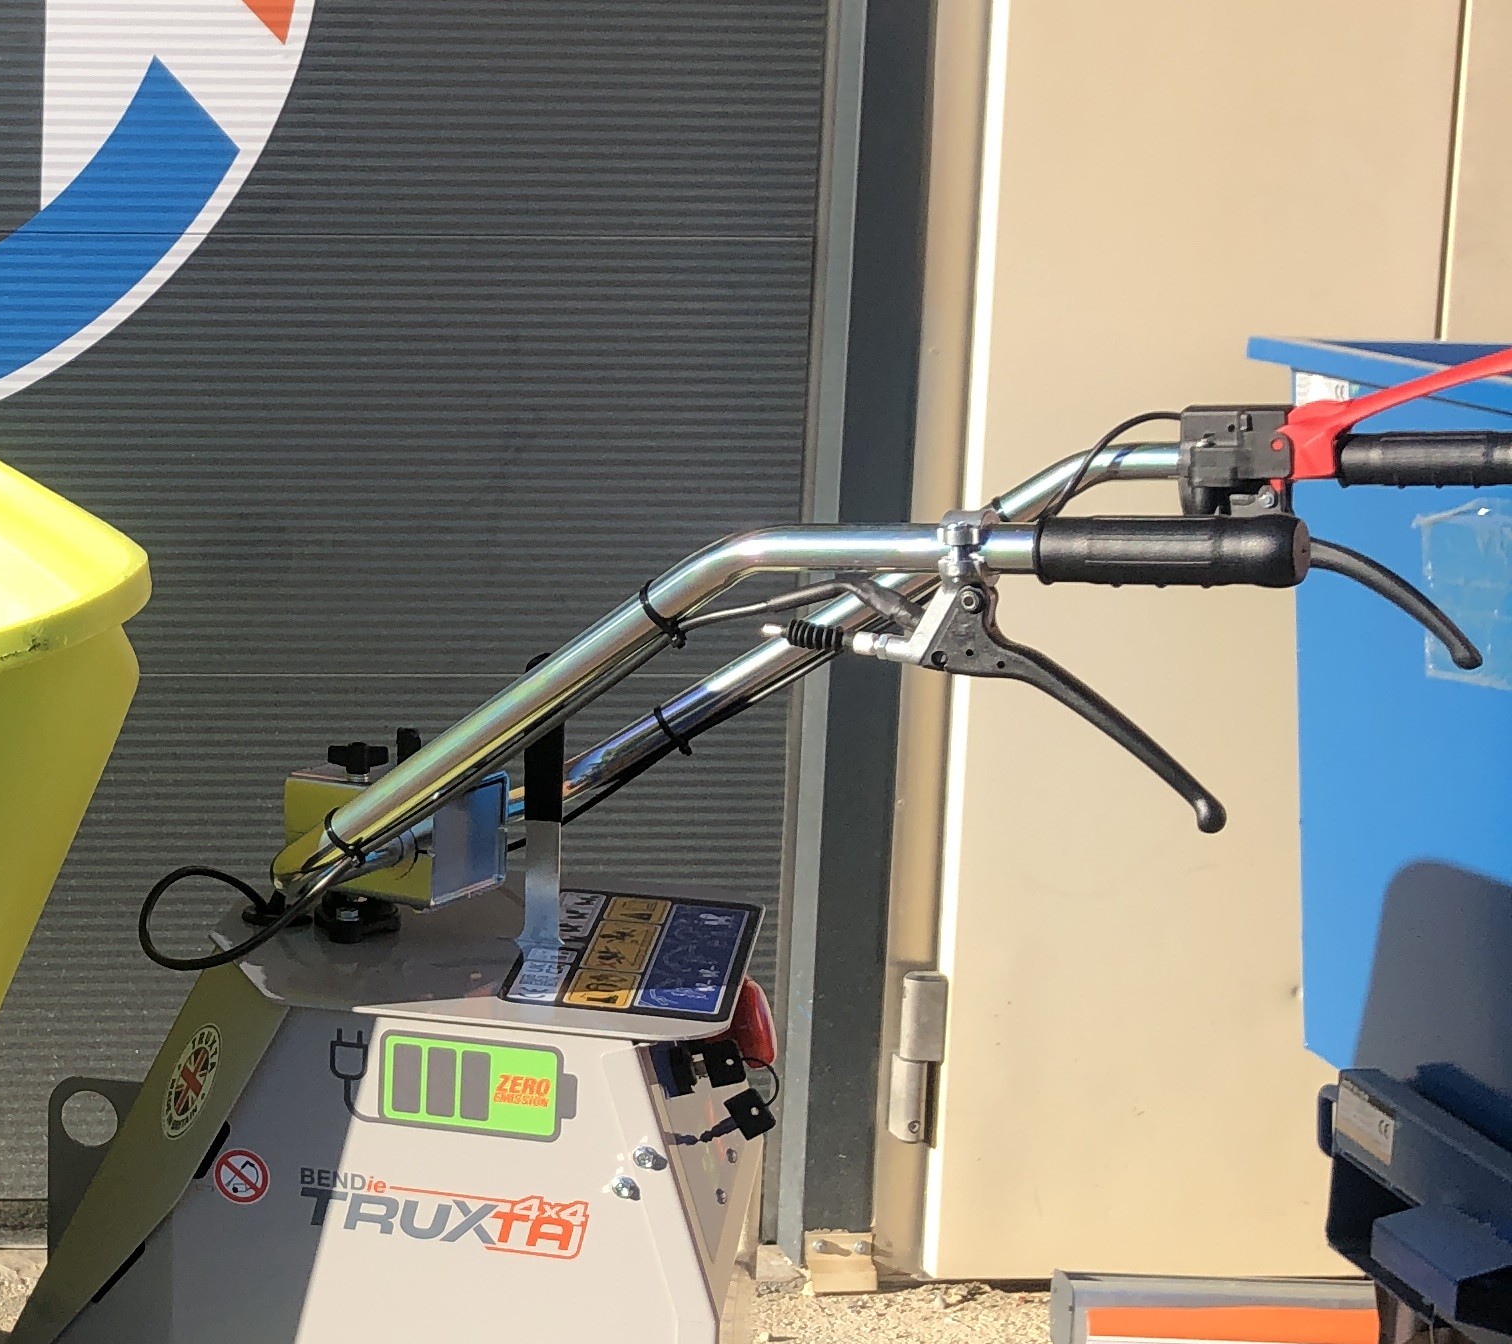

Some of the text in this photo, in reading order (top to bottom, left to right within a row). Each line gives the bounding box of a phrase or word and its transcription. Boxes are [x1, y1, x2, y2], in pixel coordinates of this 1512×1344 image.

[496, 1074, 551, 1095] ZERO
[300, 1167, 387, 1193] BENDie
[514, 1197, 587, 1224] 4x4
